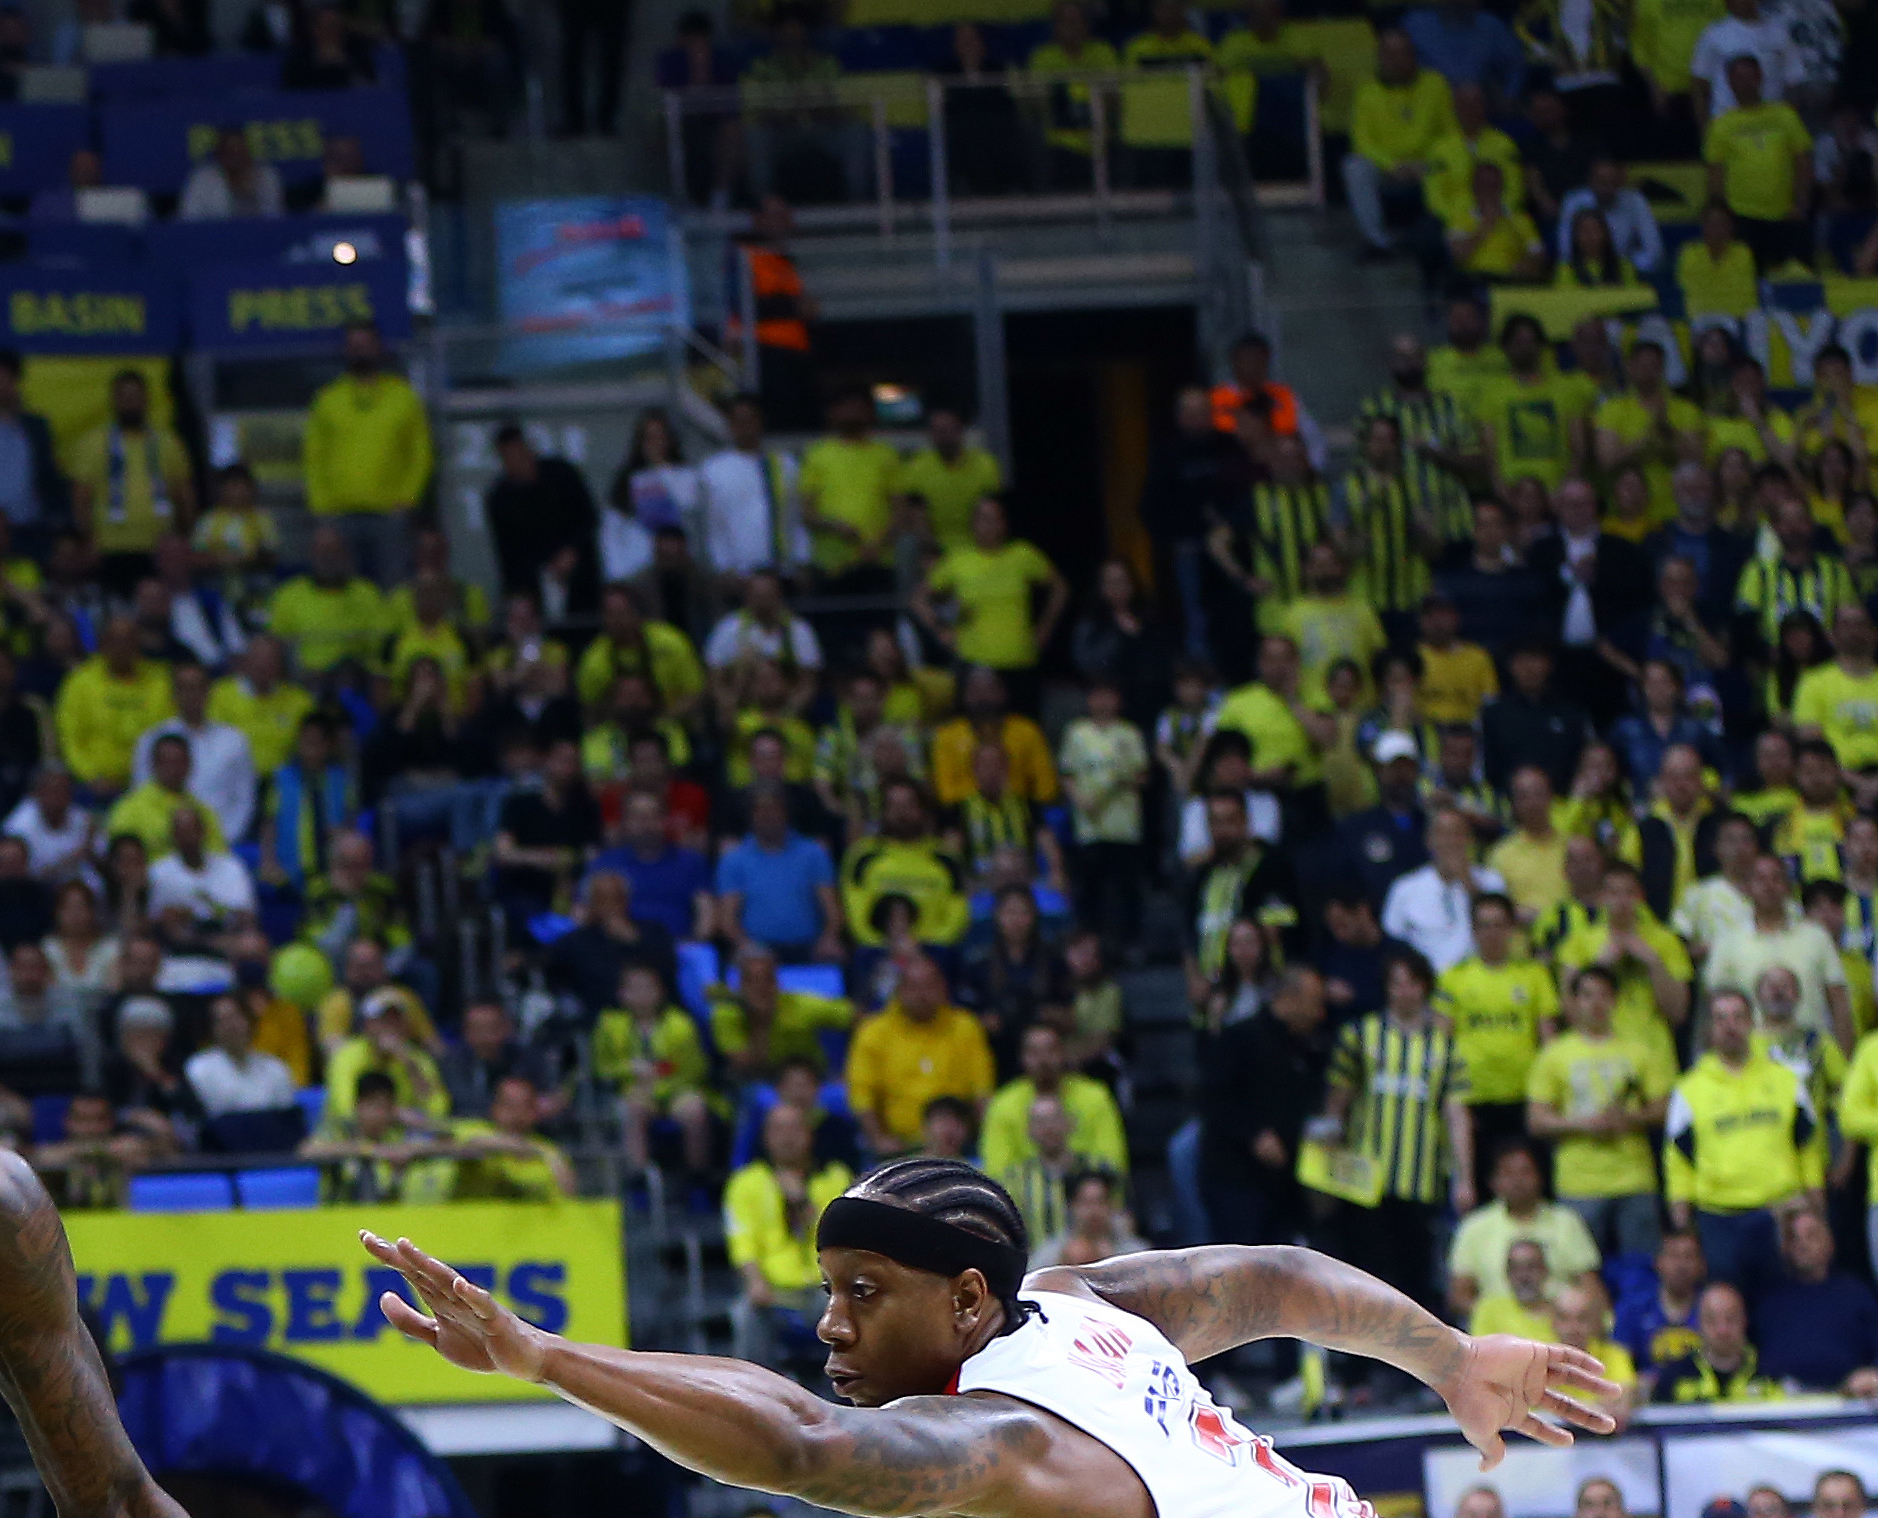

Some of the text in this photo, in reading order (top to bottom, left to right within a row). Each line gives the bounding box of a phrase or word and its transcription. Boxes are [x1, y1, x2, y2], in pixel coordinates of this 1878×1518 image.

[187, 119, 322, 161] PESS
[9, 291, 147, 335] BASIN
[228, 283, 374, 332] PRESS
